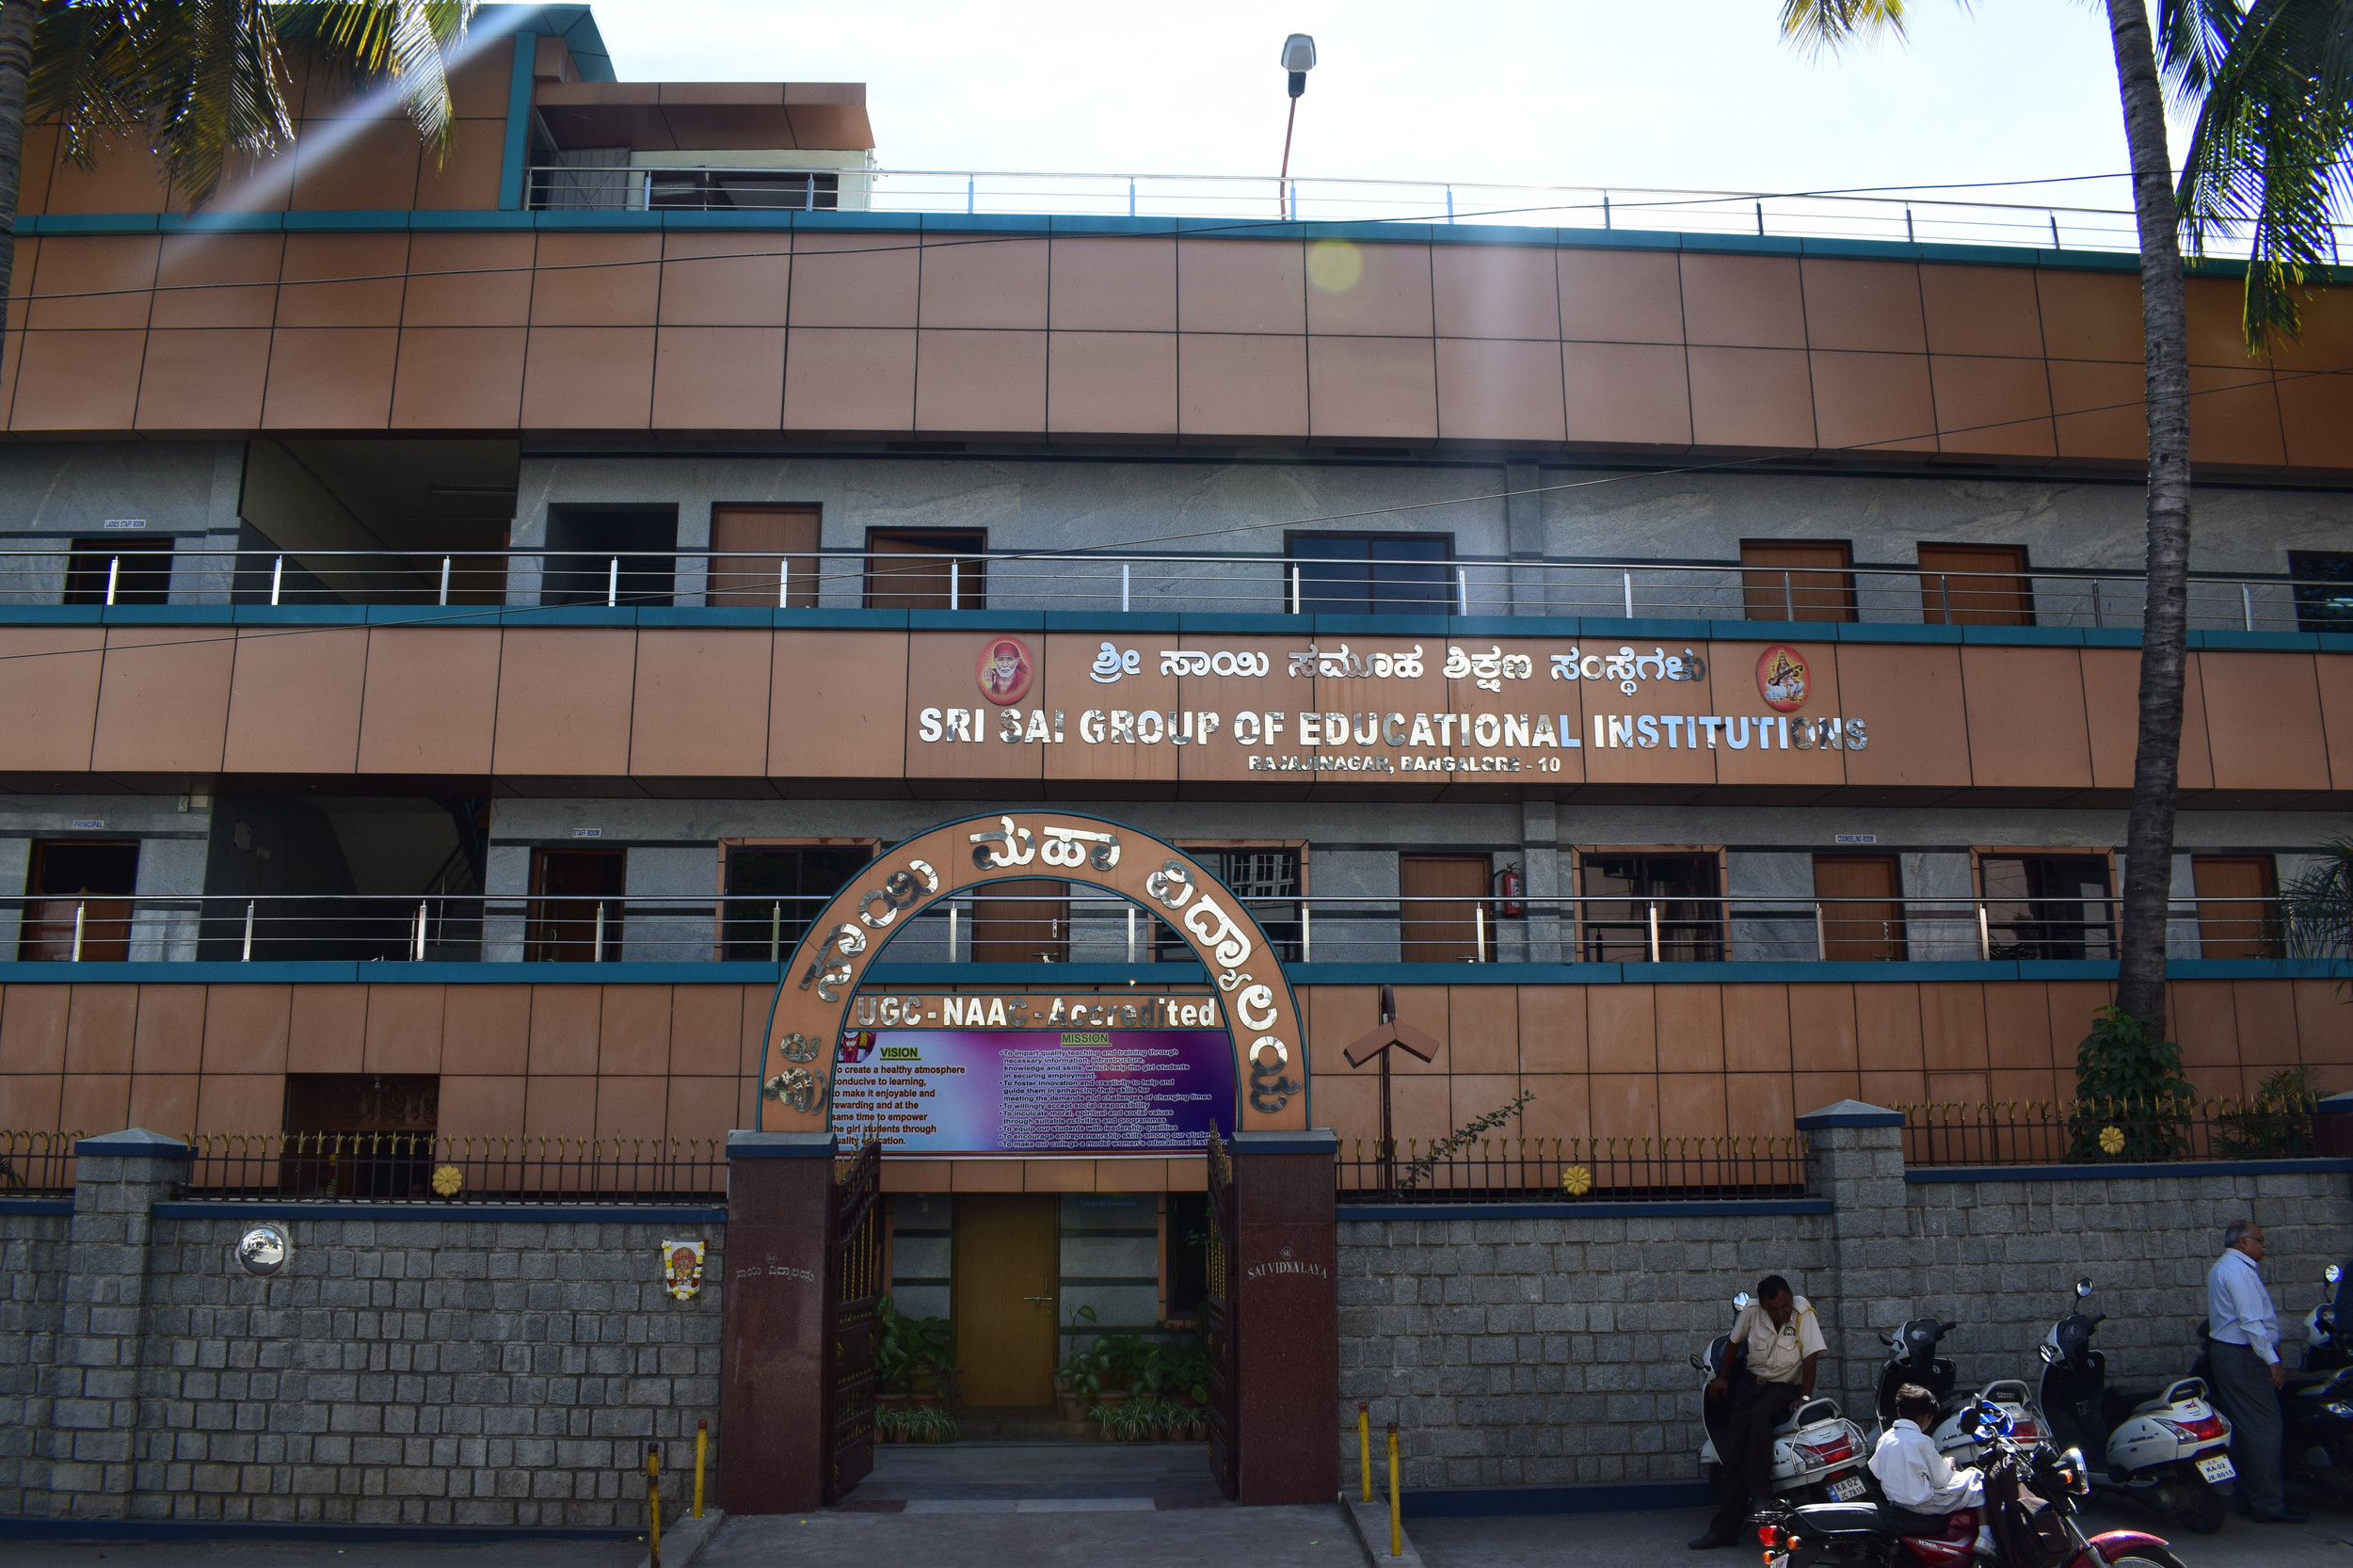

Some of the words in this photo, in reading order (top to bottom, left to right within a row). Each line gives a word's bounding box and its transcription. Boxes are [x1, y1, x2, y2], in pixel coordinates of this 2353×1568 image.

[1089, 642, 1141, 683] ಶ್ರೀ
[1160, 650, 1270, 678] ಸಾಯಿ
[1288, 643, 1424, 679] ಸಮೂಹ
[1442, 645, 1532, 693] ಶಿಕ್ಷಣ
[1549, 646, 1706, 696] ಸಂಸ್ಥೆಗಳು
[919, 708, 984, 743] SRI
[999, 708, 1064, 744] SAI
[1080, 710, 1220, 745] GROUP
[1234, 712, 1284, 745] OF
[1299, 712, 1581, 747] EDUCATIONAL
[1594, 715, 1867, 751] INSTITUTIONS
[1248, 755, 1395, 776] RAJAJINAGAR,
[1401, 756, 1520, 772] BANGALORE
[1538, 758, 1561, 772] 10
[856, 997, 921, 1026] UGC
[943, 997, 1028, 1027] NAAC
[1048, 998, 1215, 1027] Accredited
[1062, 1033, 1108, 1043] MISSION
[880, 1047, 919, 1058] VISION
[1148, 1048, 1178, 1057] through
[844, 1065, 872, 1074] create
[881, 1065, 912, 1076] healthy
[914, 1065, 966, 1076] atmosphere
[1142, 1064, 1156, 1072] girl
[888, 1077, 927, 1087] learning,
[1096, 1079, 1130, 1087] creativity
[842, 1089, 866, 1097] make
[868, 1089, 874, 1097] it
[875, 1089, 917, 1099] enjoyable
[919, 1089, 936, 1097] and
[831, 1101, 874, 1111] rewarding
[876, 1101, 892, 1110] and
[894, 1101, 904, 1110] at
[904, 1101, 919, 1110] the
[856, 1112, 875, 1121] time
[877, 1112, 886, 1121] to
[888, 1113, 928, 1123] empower
[846, 1125, 861, 1135] girl
[903, 1125, 936, 1135] through
[838, 1136, 859, 1146] uality
[1247, 1264, 1266, 1280] SAI
[1268, 1261, 1327, 1279] VIDYALAYA
[2205, 1463, 2227, 1473] KA-02
[1834, 1482, 1848, 1492] KA
[1847, 1478, 1859, 1488] 02
[1841, 1492, 1849, 1500] JC
[1849, 1486, 1865, 1496] 7815
